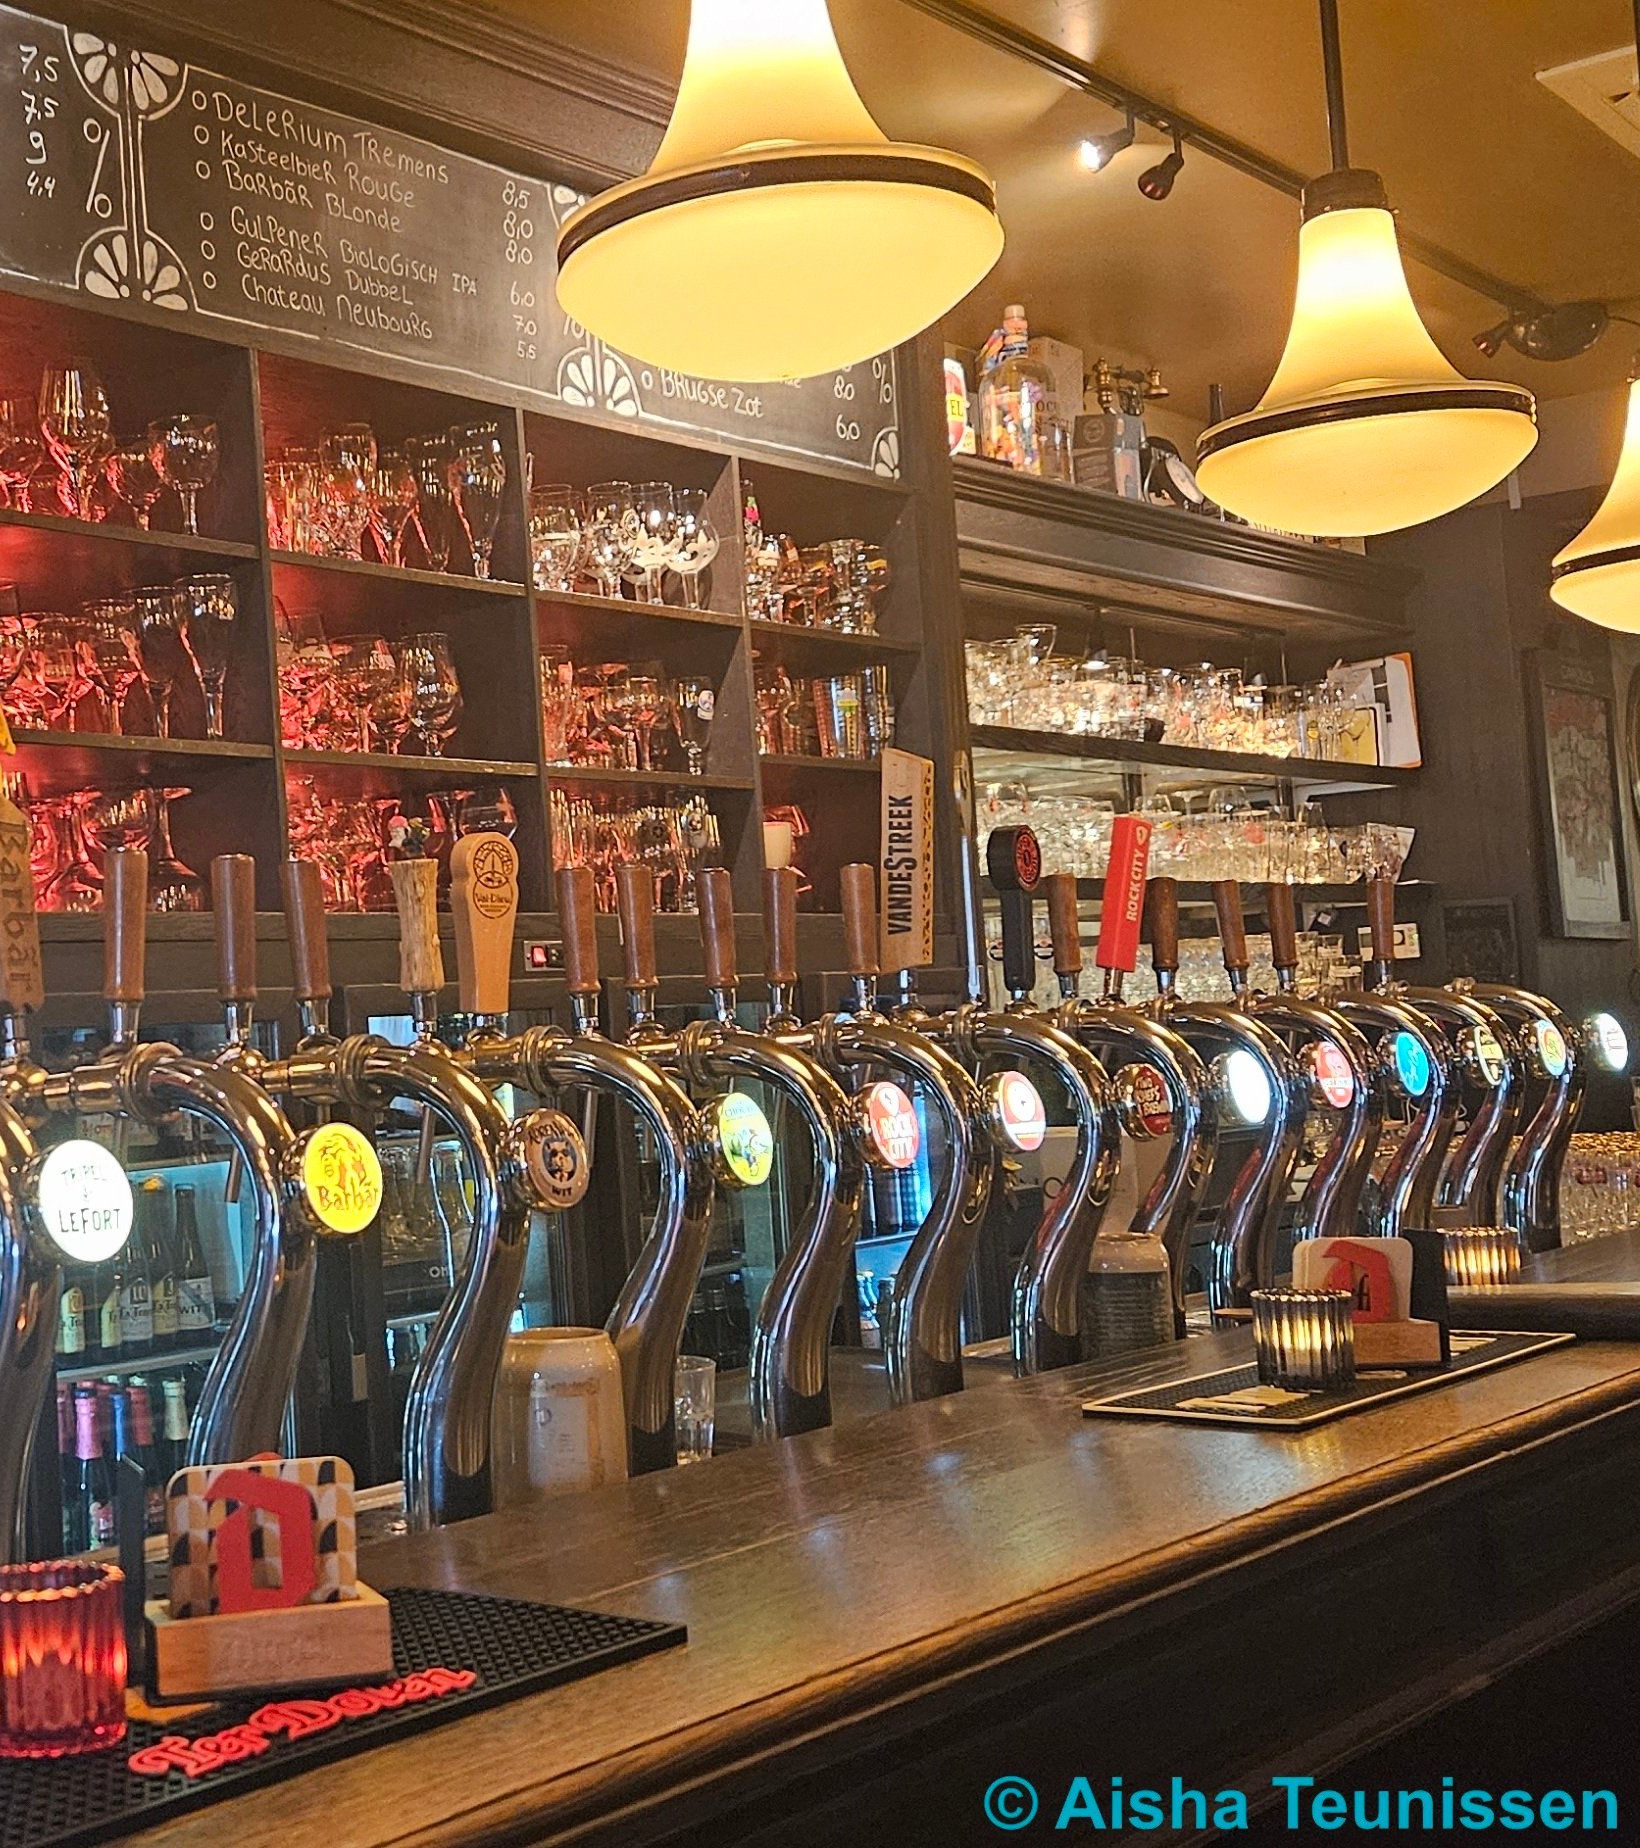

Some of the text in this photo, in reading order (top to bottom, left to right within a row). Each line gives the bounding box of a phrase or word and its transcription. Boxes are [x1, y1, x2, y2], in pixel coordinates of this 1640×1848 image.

[20, 44, 59, 83] 7,5
[21, 90, 59, 125] 7,5
[27, 170, 56, 199] 4,4
[502, 181, 531, 210] 8,5
[503, 211, 534, 240] 8,0
[505, 240, 533, 265] 8,0
[451, 273, 478, 296] IPA
[511, 281, 535, 307] 6,0
[512, 314, 538, 336] 7,0
[732, 387, 764, 418] Zot
[1126, 849, 1145, 922] ROCK CITY
